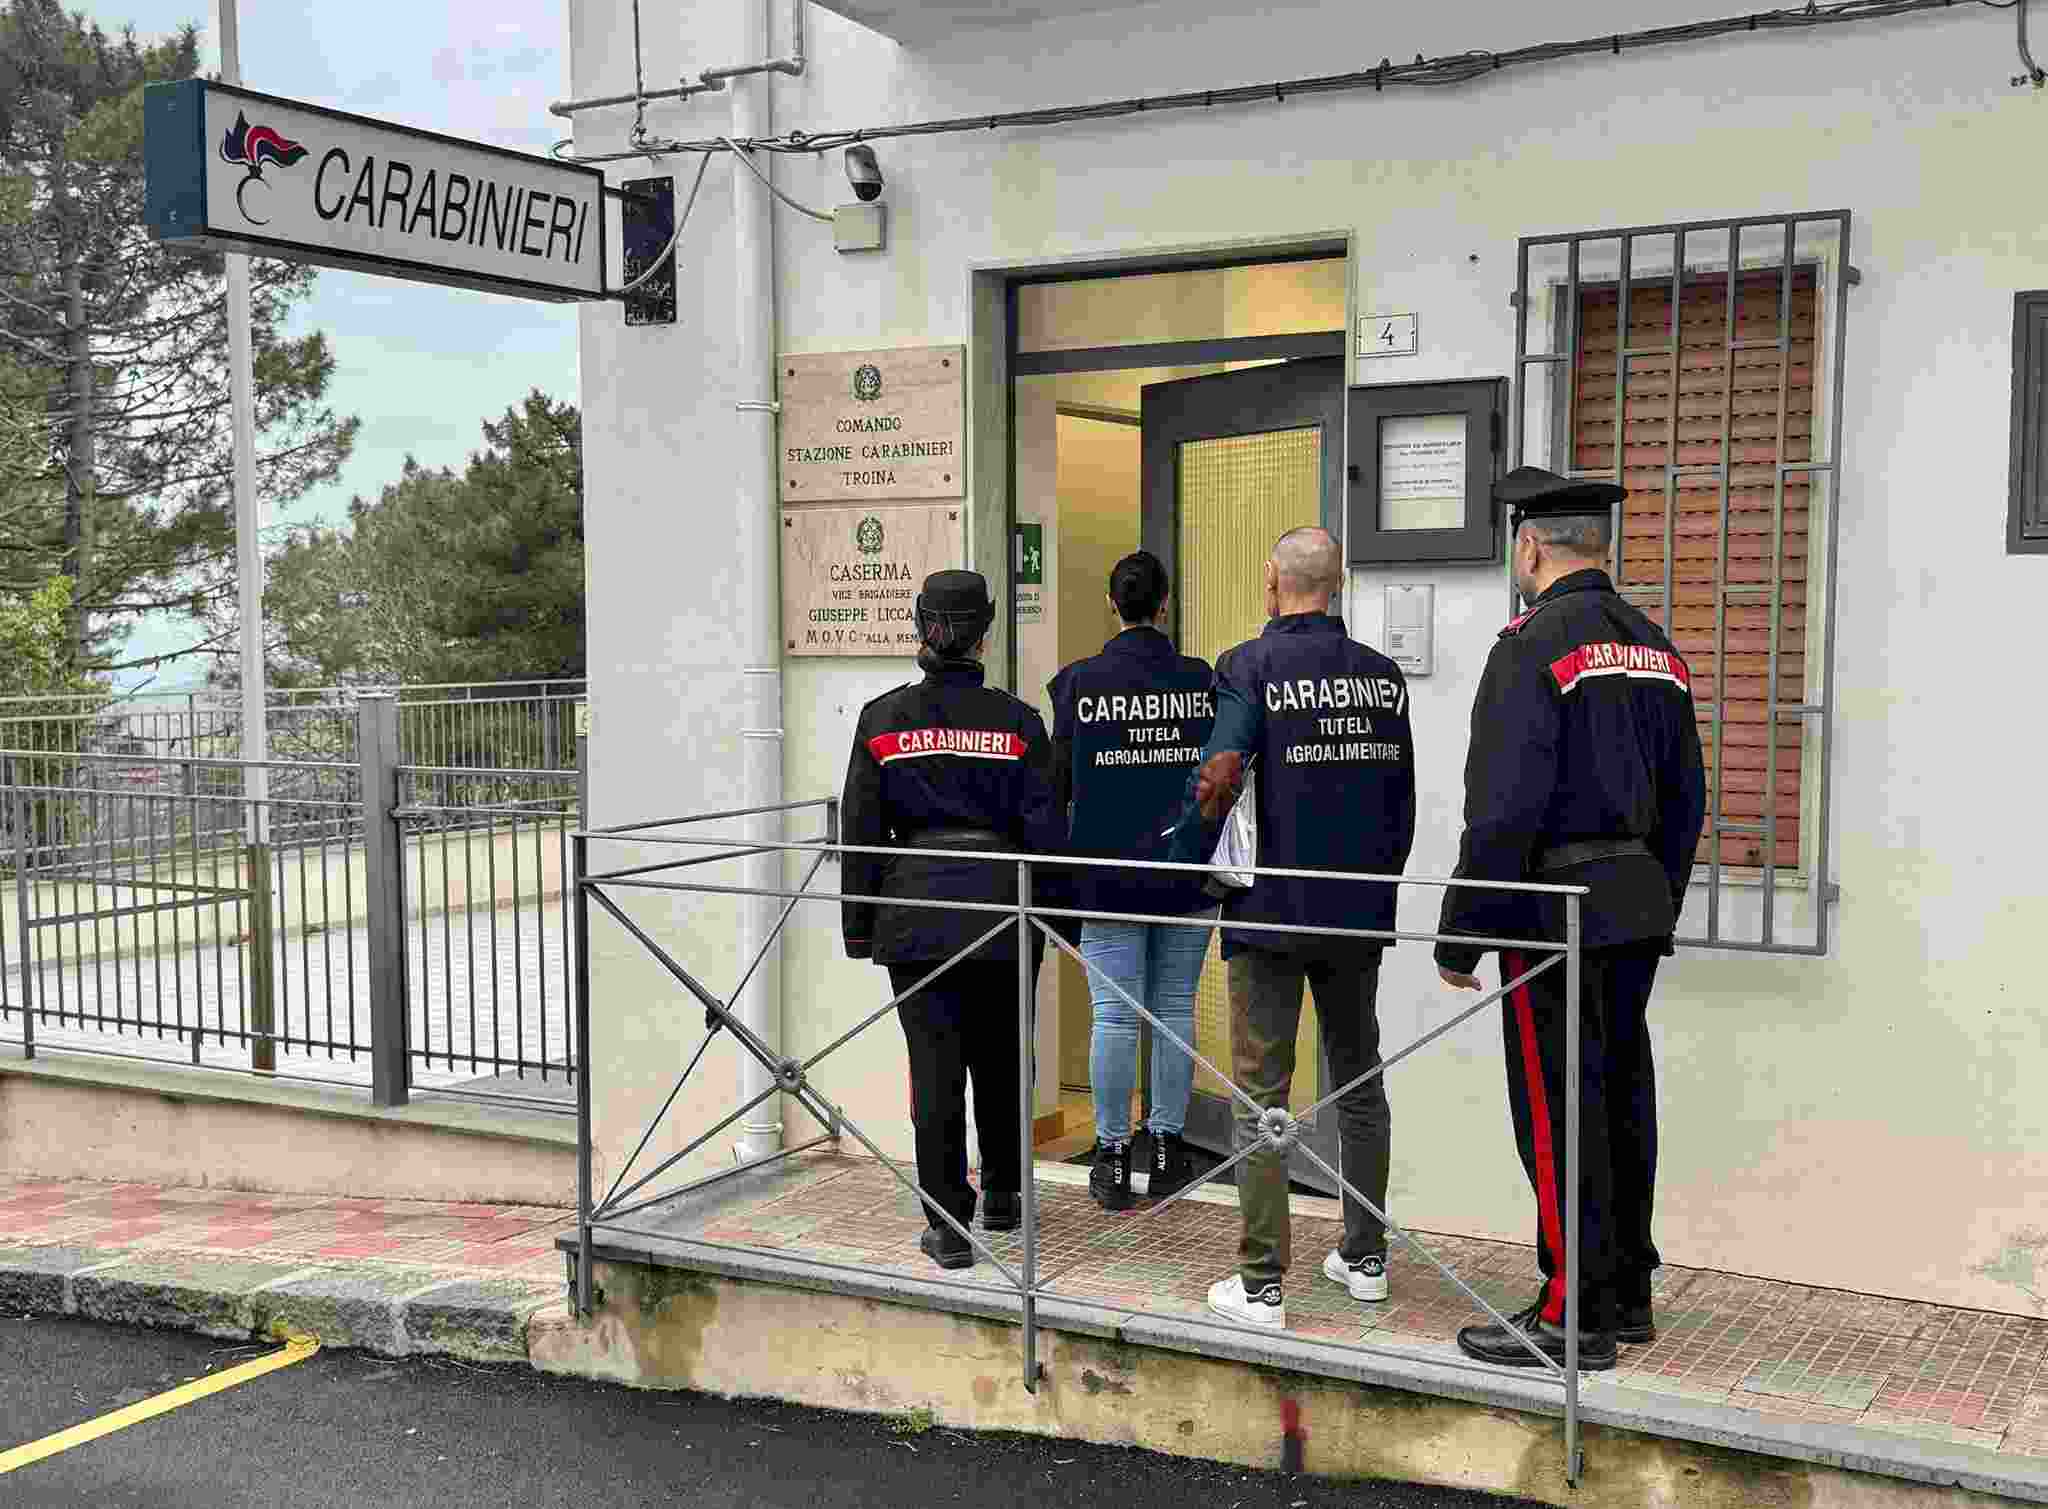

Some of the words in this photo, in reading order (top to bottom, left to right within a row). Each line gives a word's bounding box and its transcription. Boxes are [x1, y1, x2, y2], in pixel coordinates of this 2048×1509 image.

[312, 146, 589, 265] CARABINIERI
[1380, 321, 1395, 346] 4
[836, 416, 902, 433] COMANDO
[787, 446, 852, 462] STAZIONE
[861, 440, 953, 460] CARABINIERI
[843, 470, 897, 487] TROINA
[830, 562, 913, 582] CASERMA
[831, 589, 853, 601] VICE
[858, 588, 914, 600] BRIGADIERE
[808, 607, 868, 622] GIUSEPPE
[877, 607, 915, 622] LICCA
[1077, 691, 1215, 723] CARABINIER
[1127, 727, 1181, 743] TUTELA
[1318, 716, 1373, 736] TUTELA
[897, 728, 1012, 753] CARABINIERI
[1095, 746, 1208, 766] AGROALIMENTA
[1285, 741, 1401, 764] AGROALIMENTARE
